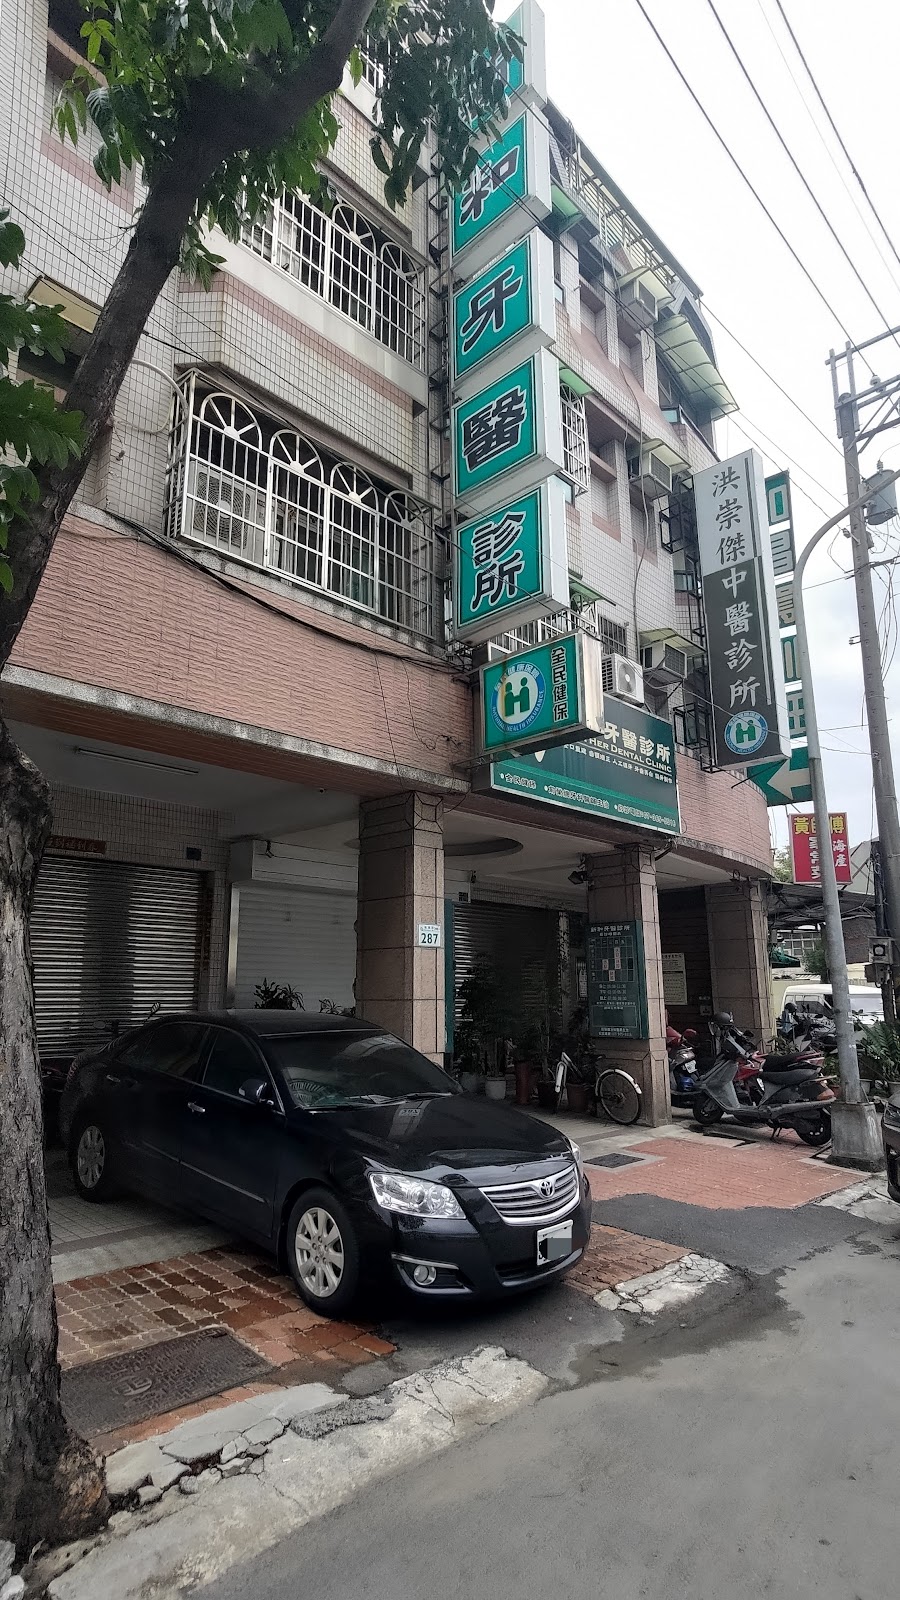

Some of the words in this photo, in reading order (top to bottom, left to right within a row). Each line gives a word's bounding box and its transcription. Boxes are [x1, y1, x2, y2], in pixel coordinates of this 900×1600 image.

[712, 466, 761, 708] 洪崇傑中醫診所
[551, 646, 569, 723] 全民健保
[526, 690, 545, 726] INSURANCE
[604, 721, 671, 764] 牙醫診所
[610, 745, 645, 764] DENTAL
[645, 757, 672, 774] CLINIC
[832, 839, 848, 867] 海產
[421, 933, 439, 944] 287
